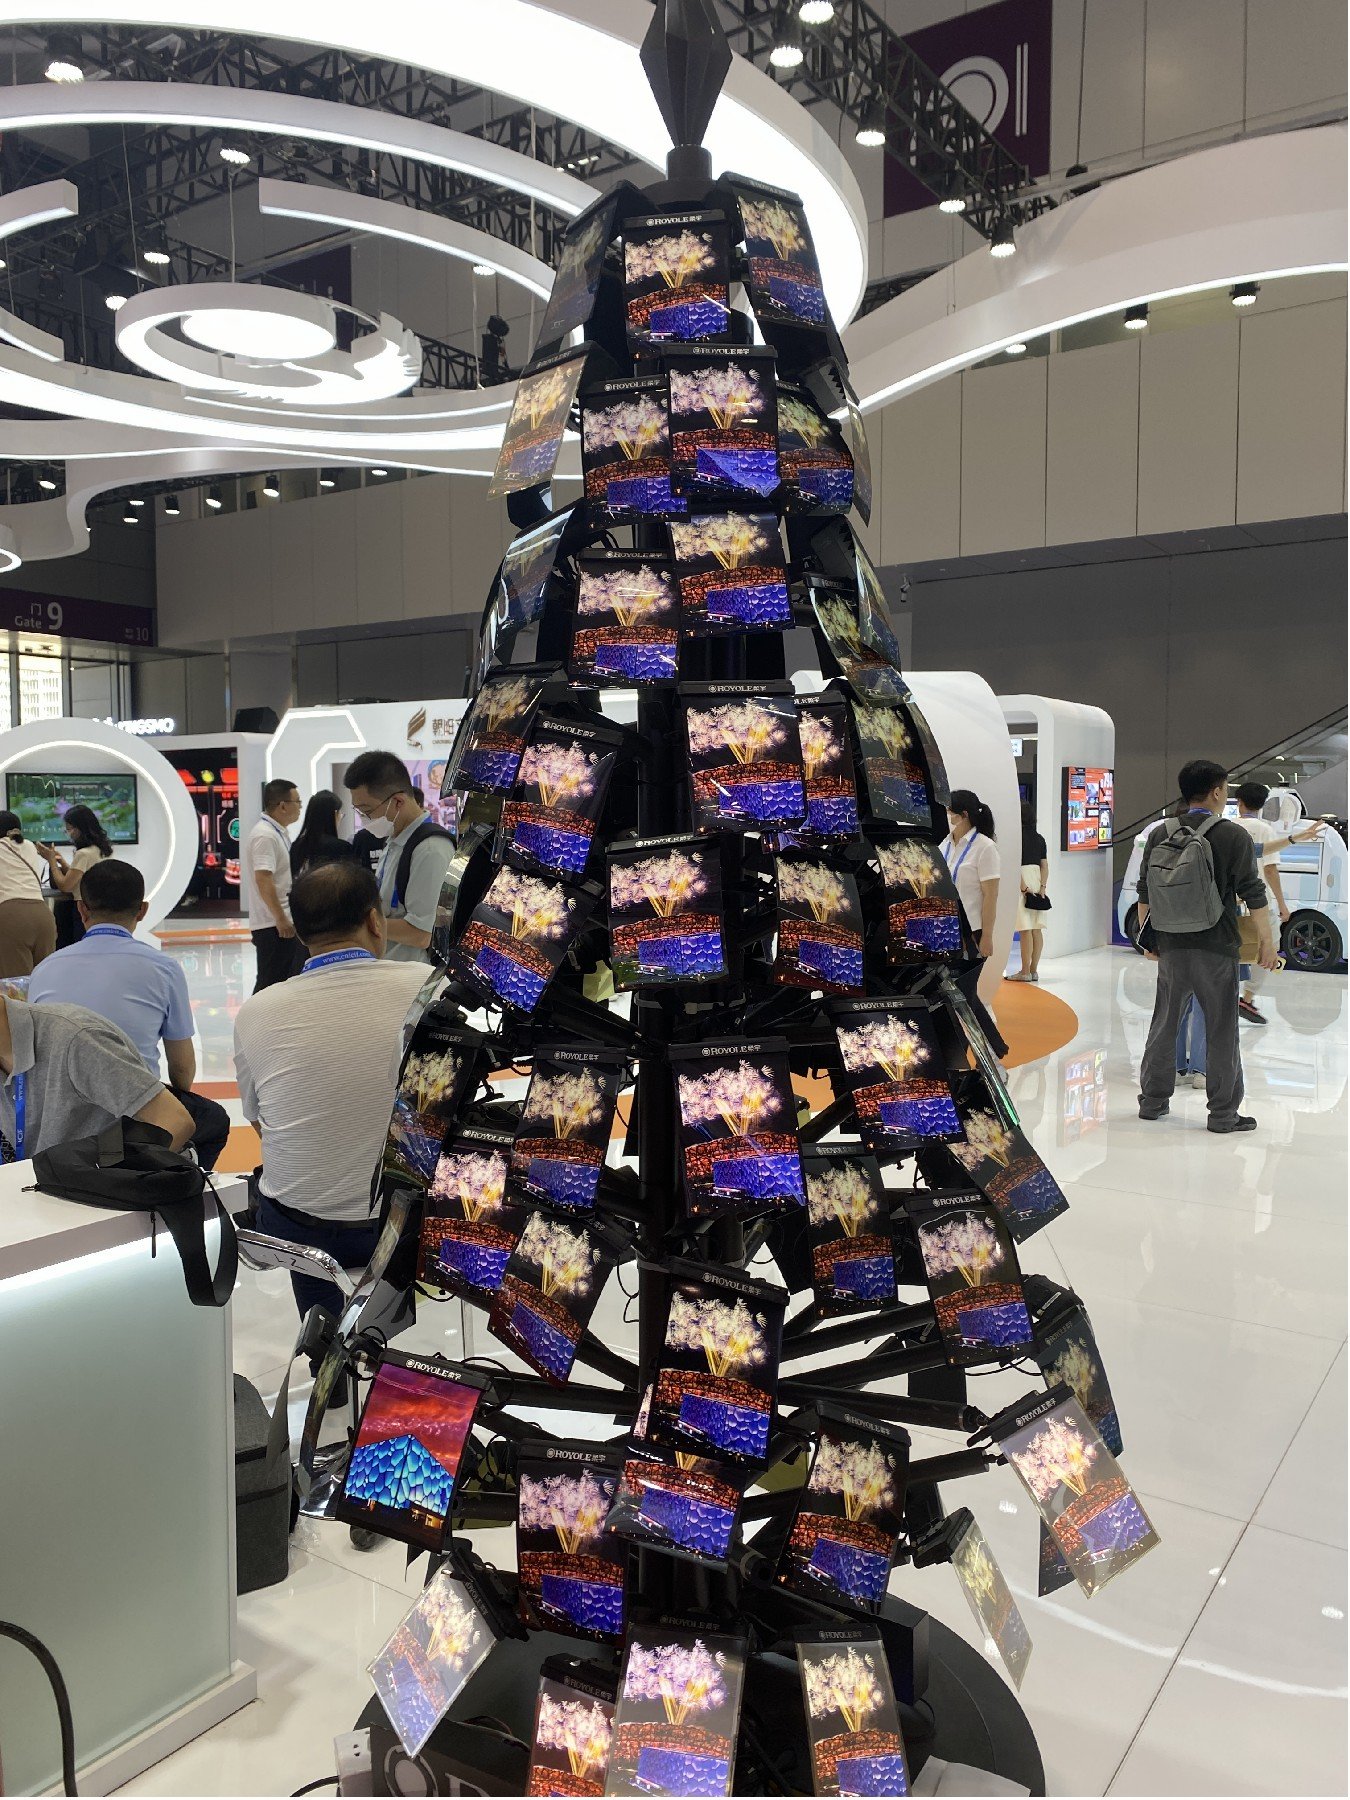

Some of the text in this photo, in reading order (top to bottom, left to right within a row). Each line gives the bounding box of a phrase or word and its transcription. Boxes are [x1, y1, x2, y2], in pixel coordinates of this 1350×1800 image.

[15, 602, 63, 630] Gate 9
[136, 627, 149, 642] 10
